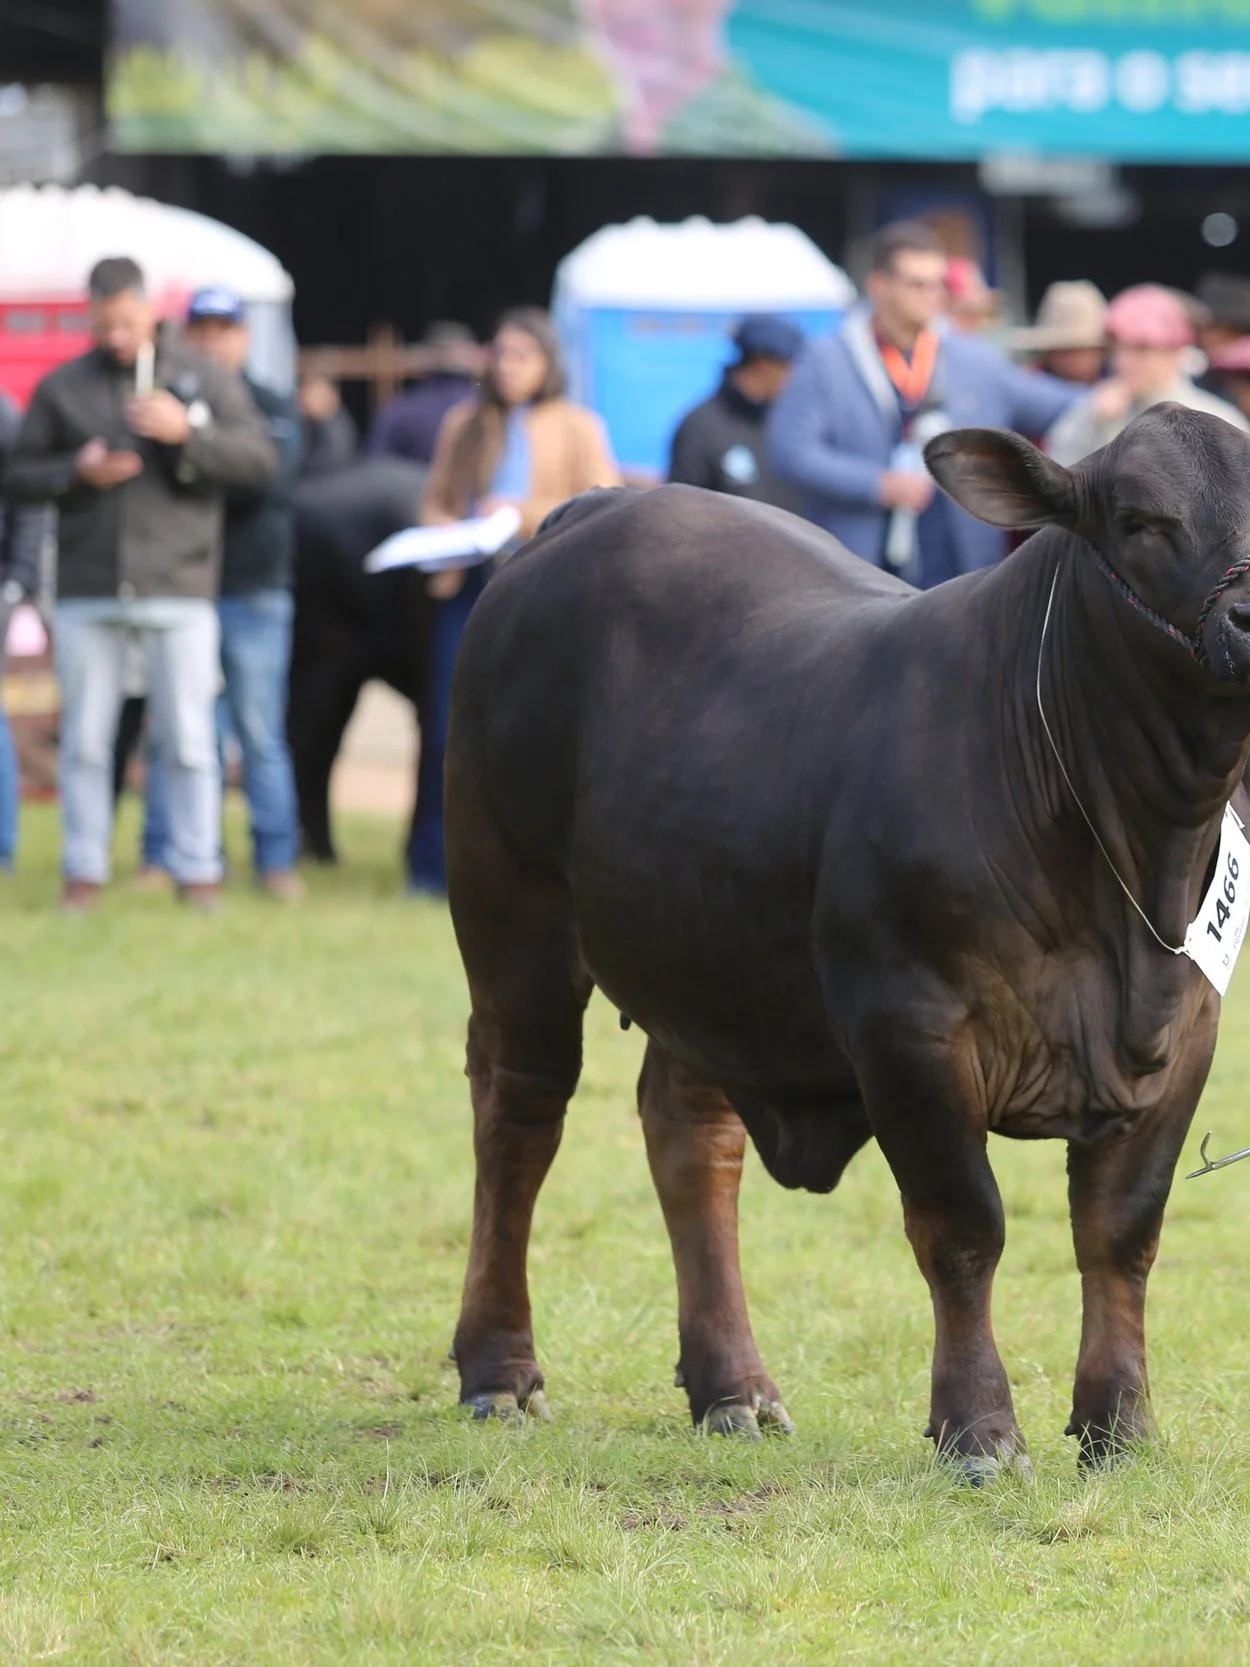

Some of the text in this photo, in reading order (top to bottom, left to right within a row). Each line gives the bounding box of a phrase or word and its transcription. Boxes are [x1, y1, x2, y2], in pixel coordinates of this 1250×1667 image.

[951, 48, 1108, 124] para
[1115, 49, 1168, 113] o
[1206, 851, 1240, 943] 1466
